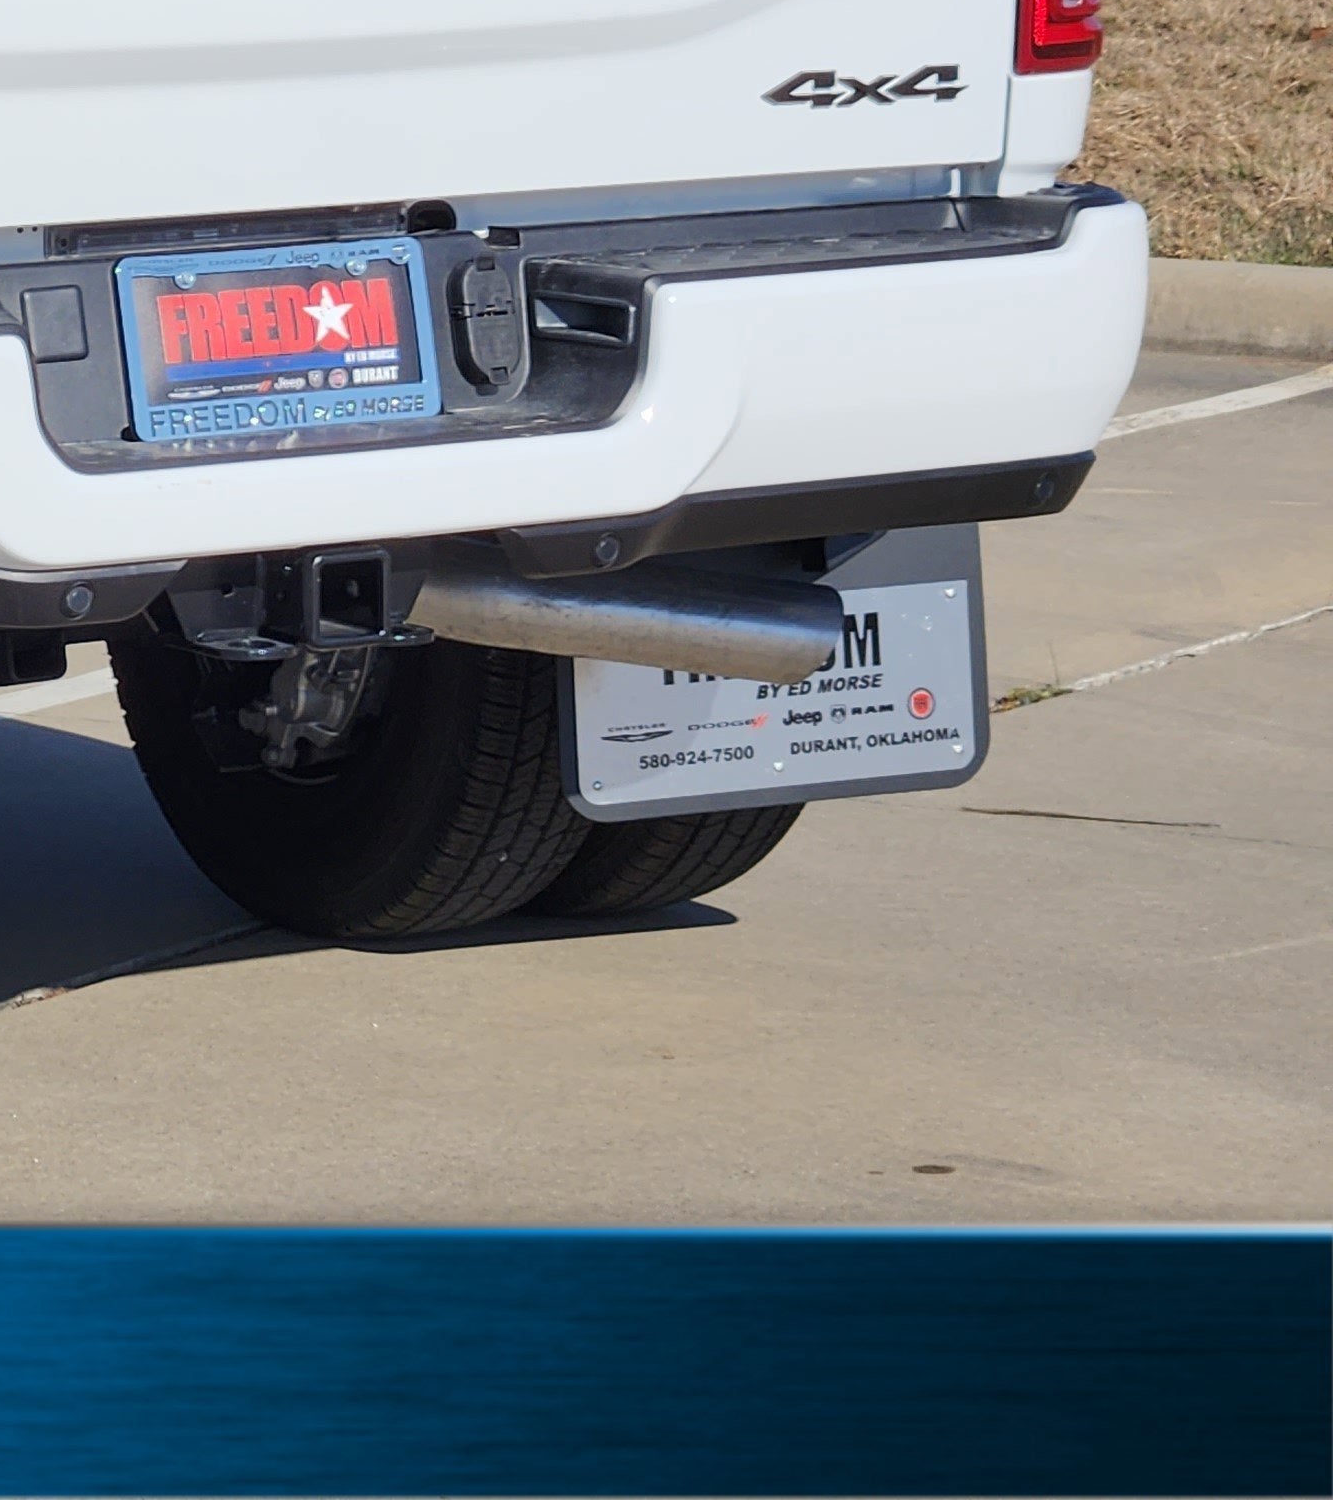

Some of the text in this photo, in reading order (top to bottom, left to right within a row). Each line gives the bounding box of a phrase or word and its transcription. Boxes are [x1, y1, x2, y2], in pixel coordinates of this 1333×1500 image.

[760, 64, 969, 109] 4x4
[286, 250, 319, 264] Jeep
[156, 277, 399, 364] FREEDOM
[352, 365, 399, 384] DURANT
[150, 397, 308, 437] FREEDOM
[361, 394, 425, 416] MORSE
[757, 673, 883, 699] BY ED MORSE
[782, 709, 823, 726] Jeep
[851, 703, 895, 716] RAM
[790, 727, 961, 755] DURANT, OKLAHOMA
[639, 745, 755, 770] 580-924-7500
